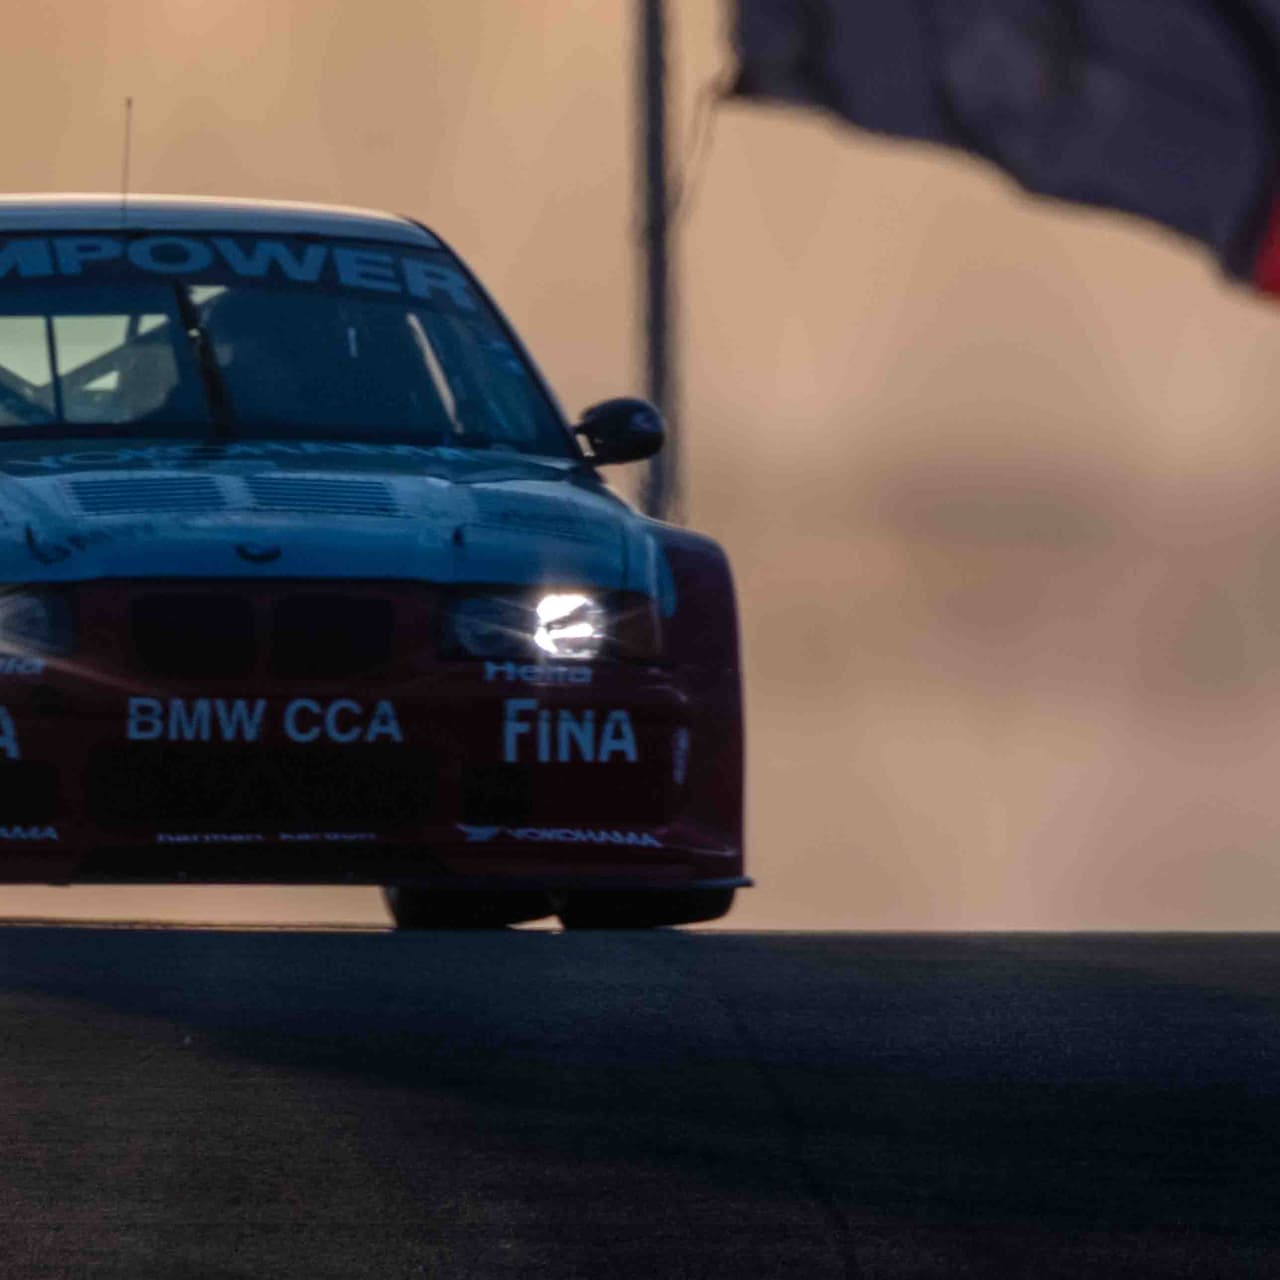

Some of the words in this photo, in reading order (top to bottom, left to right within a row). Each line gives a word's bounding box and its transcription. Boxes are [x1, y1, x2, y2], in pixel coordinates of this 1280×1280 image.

[127, 696, 268, 742] BMW
[282, 697, 405, 744] CCA
[501, 697, 639, 763] FINA
[505, 825, 664, 849] YOKOHAMA
